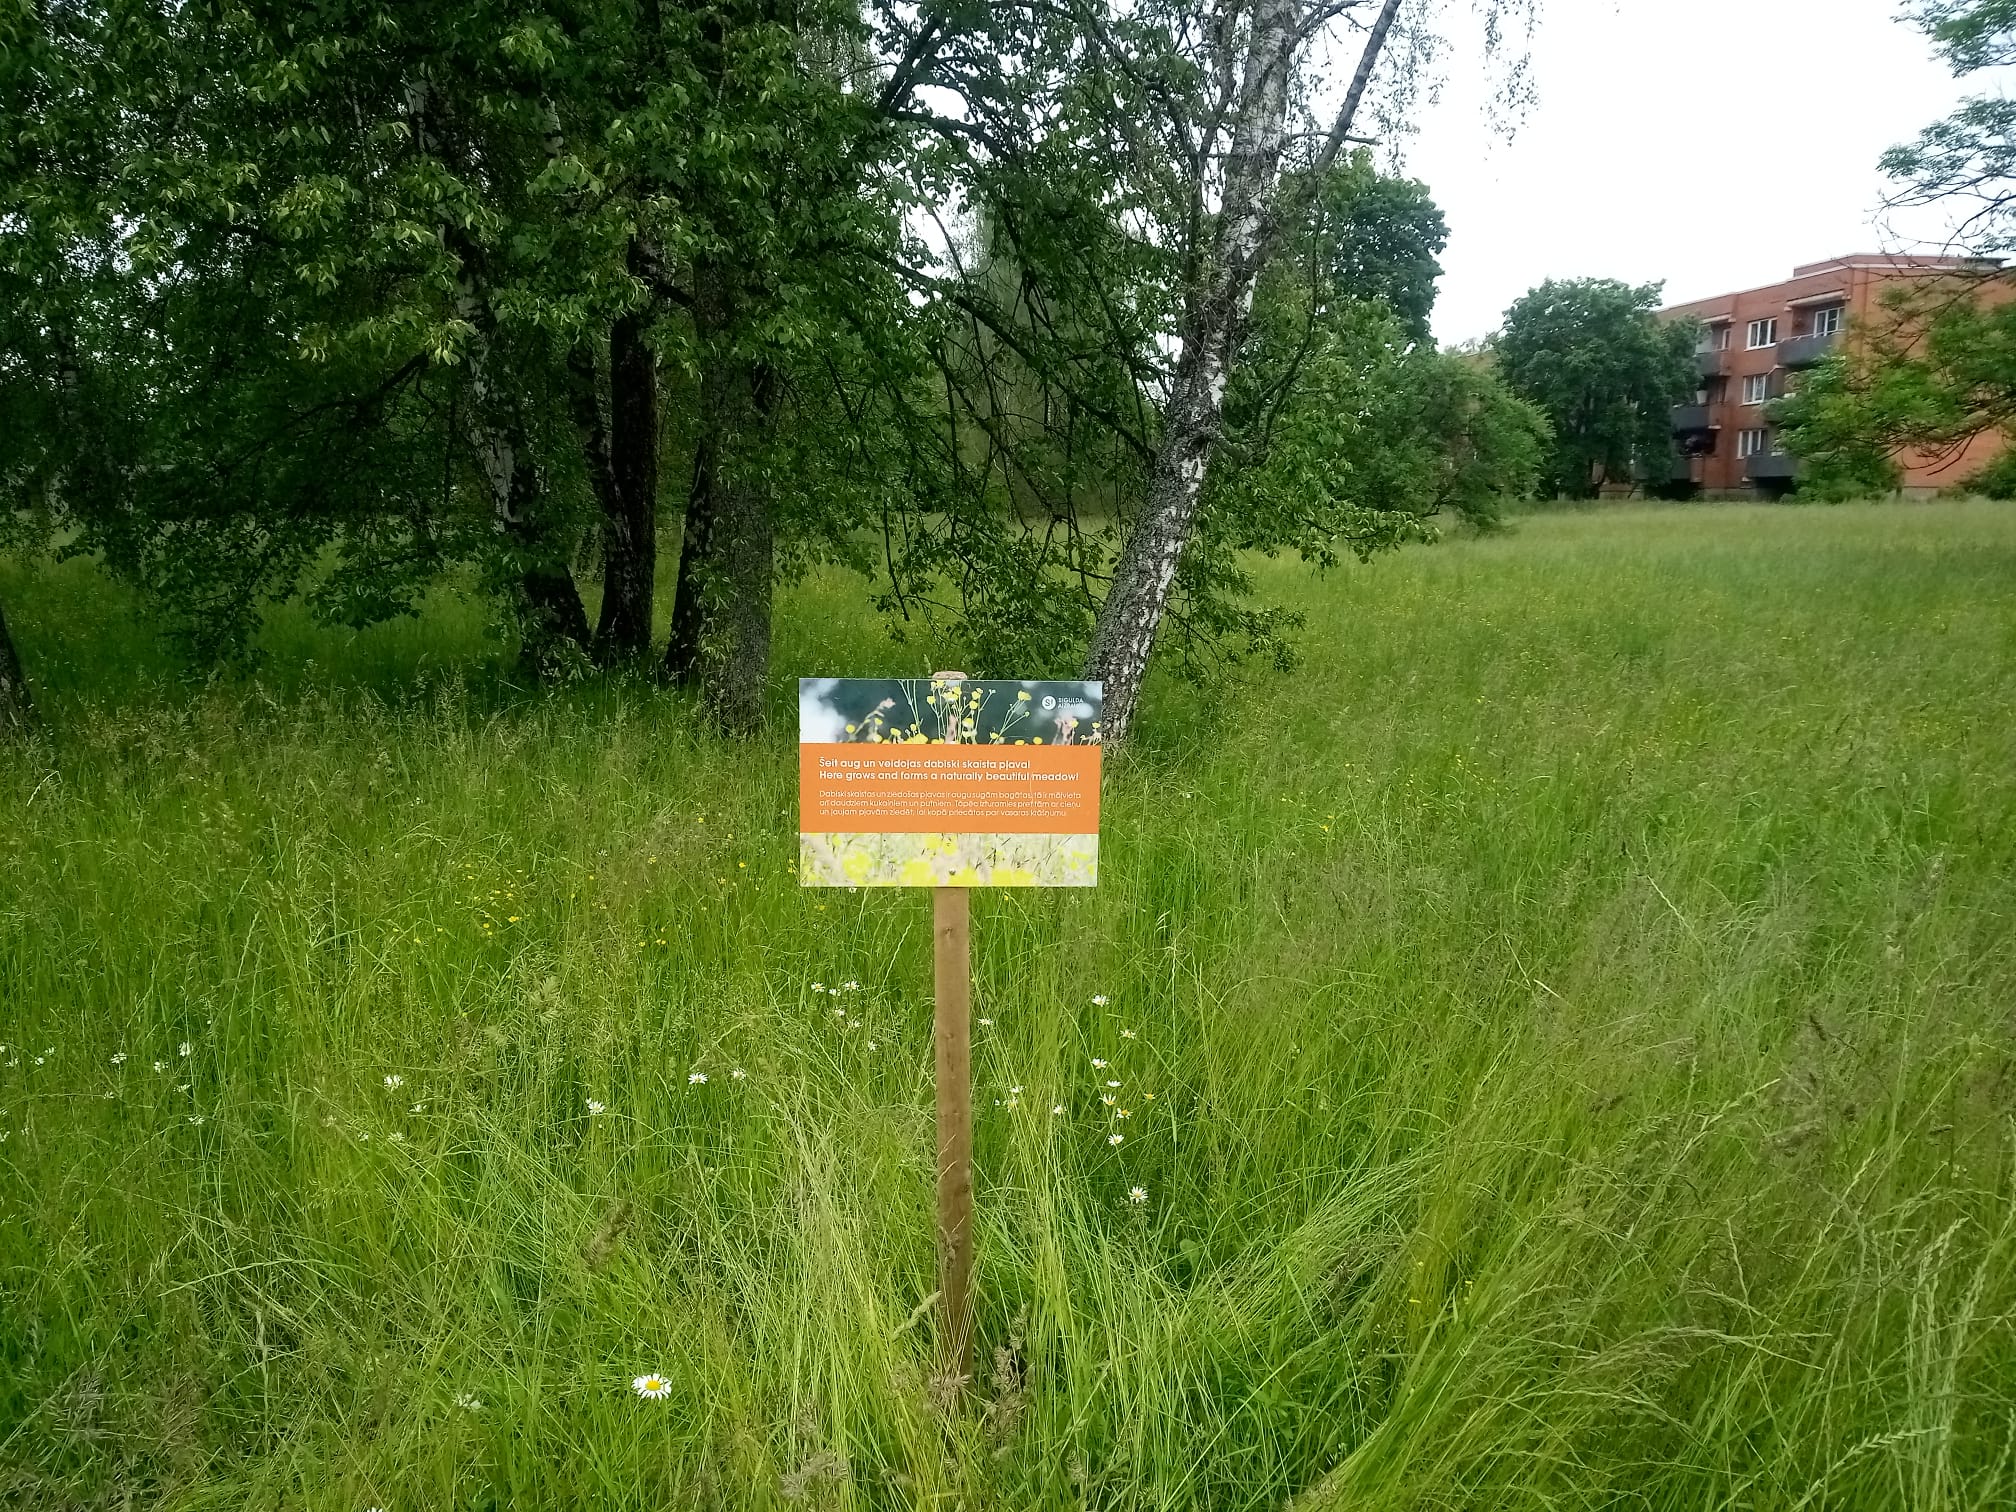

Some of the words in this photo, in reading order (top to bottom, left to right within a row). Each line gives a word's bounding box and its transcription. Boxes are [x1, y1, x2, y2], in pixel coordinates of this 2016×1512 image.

[819, 757, 838, 768] Šeit
[840, 760, 860, 769] aug
[863, 760, 875, 768] un
[878, 759, 921, 769] veidojas
[924, 760, 960, 768] dabiski
[962, 760, 996, 769] skaista
[820, 771, 843, 780] Here
[846, 772, 875, 781] grows
[878, 771, 898, 780] and
[901, 771, 928, 780] forms
[940, 771, 983, 782] naturally
[985, 772, 1029, 781] beautiful
[1032, 773, 1079, 781] meadow!
[886, 790, 919, 798] ziedošas
[830, 799, 868, 807] daudziem
